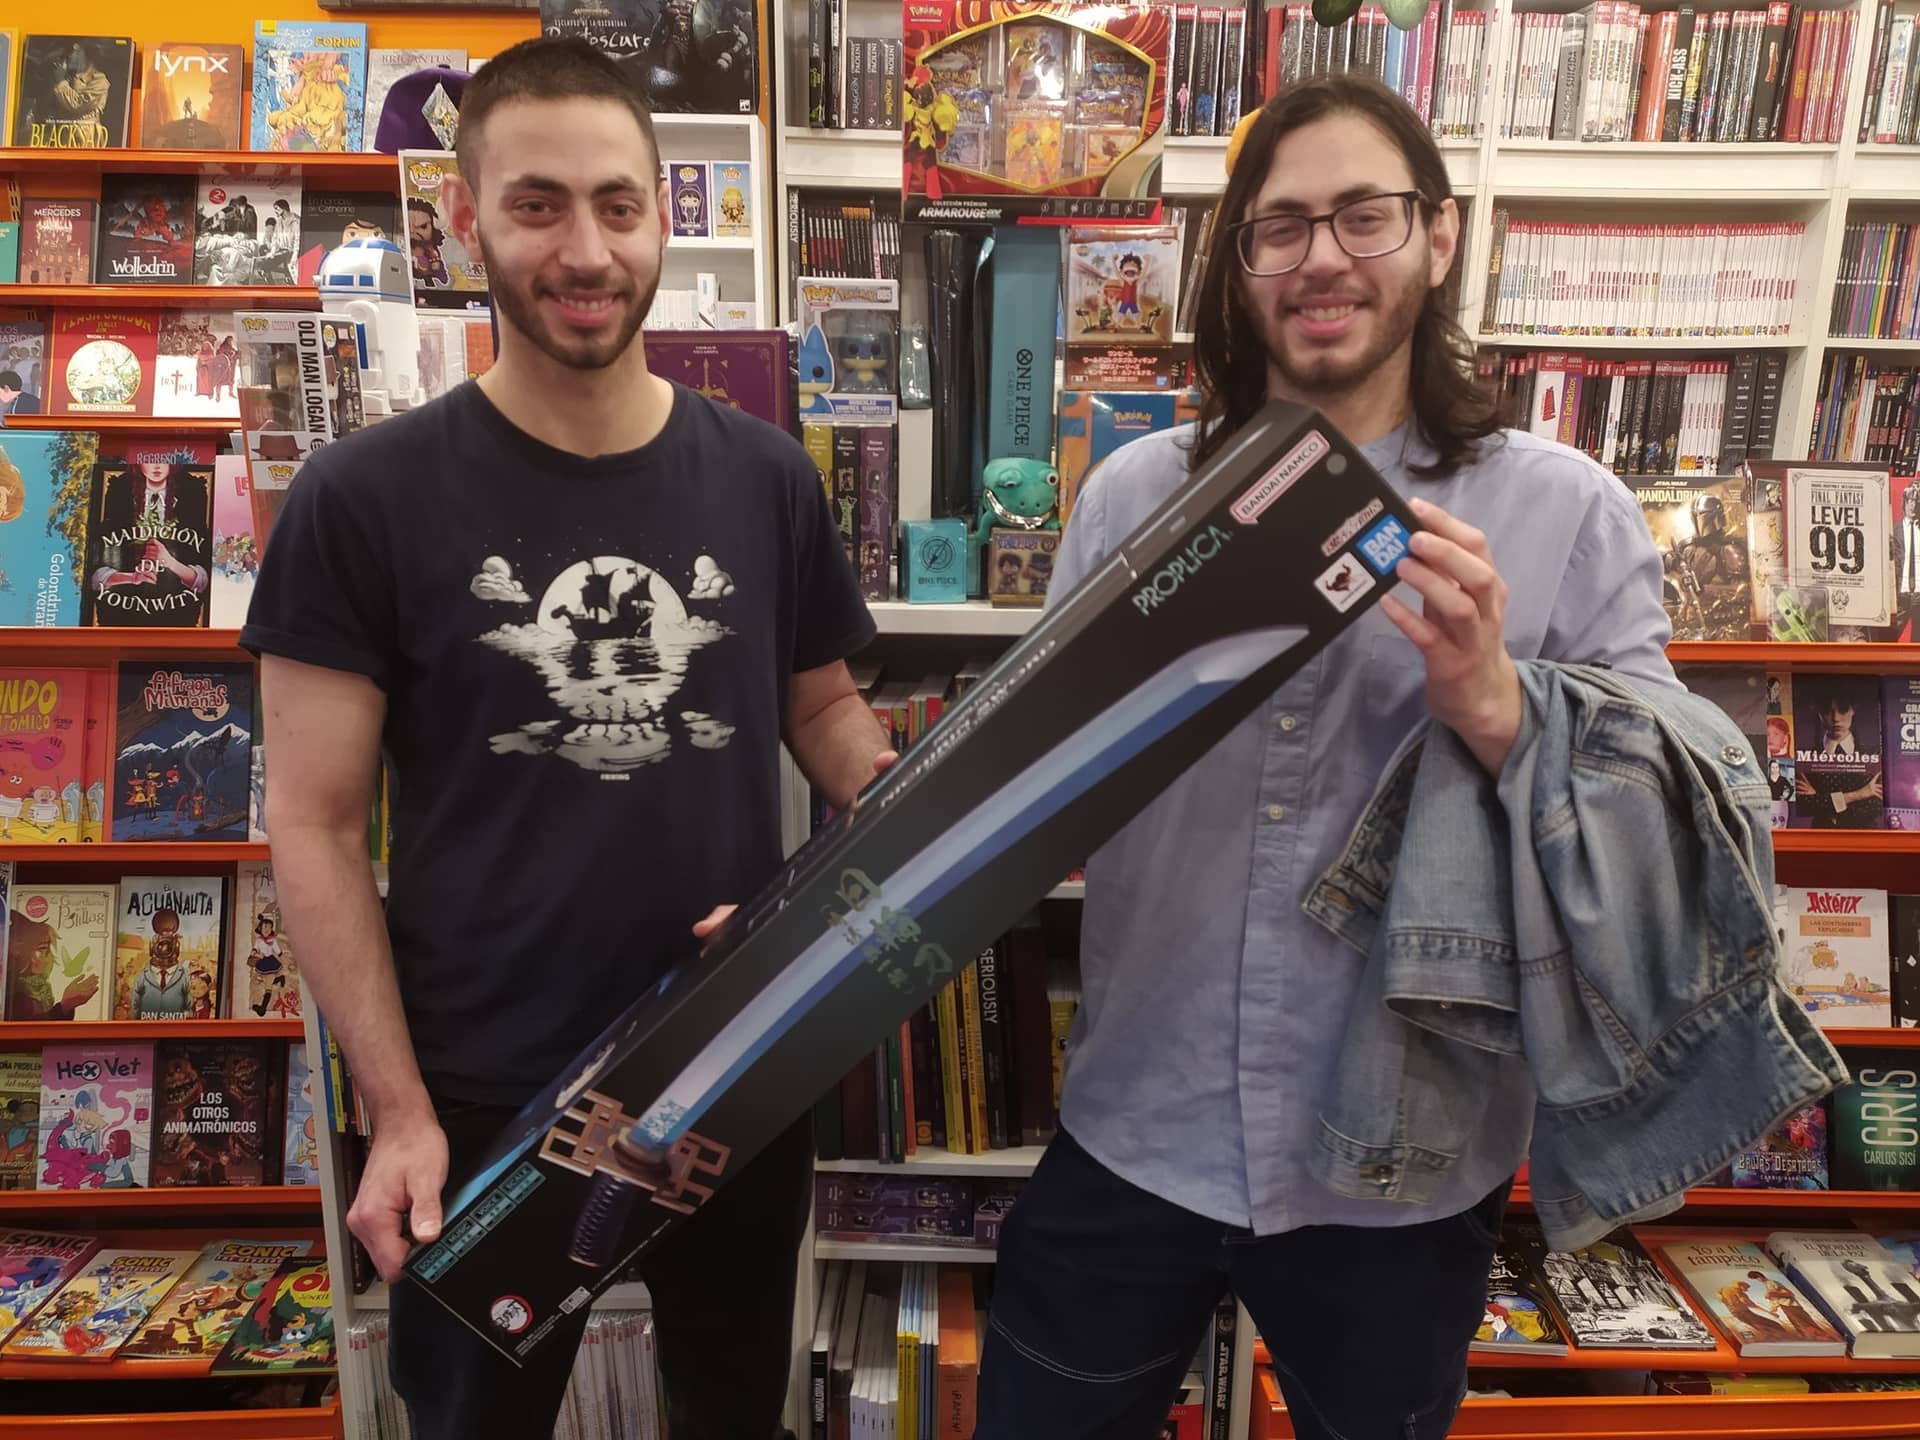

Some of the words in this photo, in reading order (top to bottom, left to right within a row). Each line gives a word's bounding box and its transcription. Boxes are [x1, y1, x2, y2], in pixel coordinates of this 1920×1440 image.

[314, 37, 360, 48] FORUM
[154, 49, 229, 77] lynx
[31, 123, 109, 148] BLACKSAD
[409, 165, 443, 180] POP!
[33, 208, 81, 217] MERCEDES
[918, 207, 987, 218] ARMAROUGE
[298, 320, 315, 347] OLD
[301, 352, 320, 384] MAN
[1016, 349, 1033, 391] ONE
[305, 388, 326, 433] LOGAN
[1014, 396, 1032, 446] PIECE
[1241, 478, 1280, 515] BANDAI
[1278, 441, 1319, 481] NAMCO
[145, 493, 166, 507] LA
[1811, 491, 1830, 505] FINAL
[1836, 491, 1864, 506] FANTASY
[1811, 506, 1864, 526] LEVEL
[102, 525, 205, 554] MALDICIÓN
[1362, 520, 1402, 555] BAN
[1377, 540, 1406, 569] DAI
[1809, 526, 1865, 574] 99
[135, 559, 166, 573] DE
[1131, 525, 1233, 616] PROPLICA
[97, 583, 200, 614] YOUNWITY
[0, 679, 58, 715] NDO
[0, 715, 50, 732] TOMICO
[1796, 750, 1880, 763] Miércoles
[980, 948, 998, 1024] SERIOUSLY
[141, 1011, 158, 1020] DAN
[57, 1060, 102, 1081] Hex
[103, 1057, 142, 1077] Vet
[200, 1092, 223, 1104] LOS
[1859, 1069, 1919, 1147] GRIS
[192, 1107, 230, 1119] OTROS
[163, 1120, 257, 1134] ANIMATRÓNICOS
[1864, 1150, 1896, 1165] CARLOS
[476, 1194, 500, 1218] VOICE
[5, 1233, 91, 1249] SONIC
[220, 1243, 299, 1258] SONIC
[1689, 1246, 1712, 1255] Yo
[1727, 1245, 1741, 1254] ti
[112, 1256, 177, 1267] SONIC
[1687, 1254, 1761, 1267] tampoco
[1218, 1342, 1230, 1376] STAR
[1216, 1376, 1228, 1410] WARS
